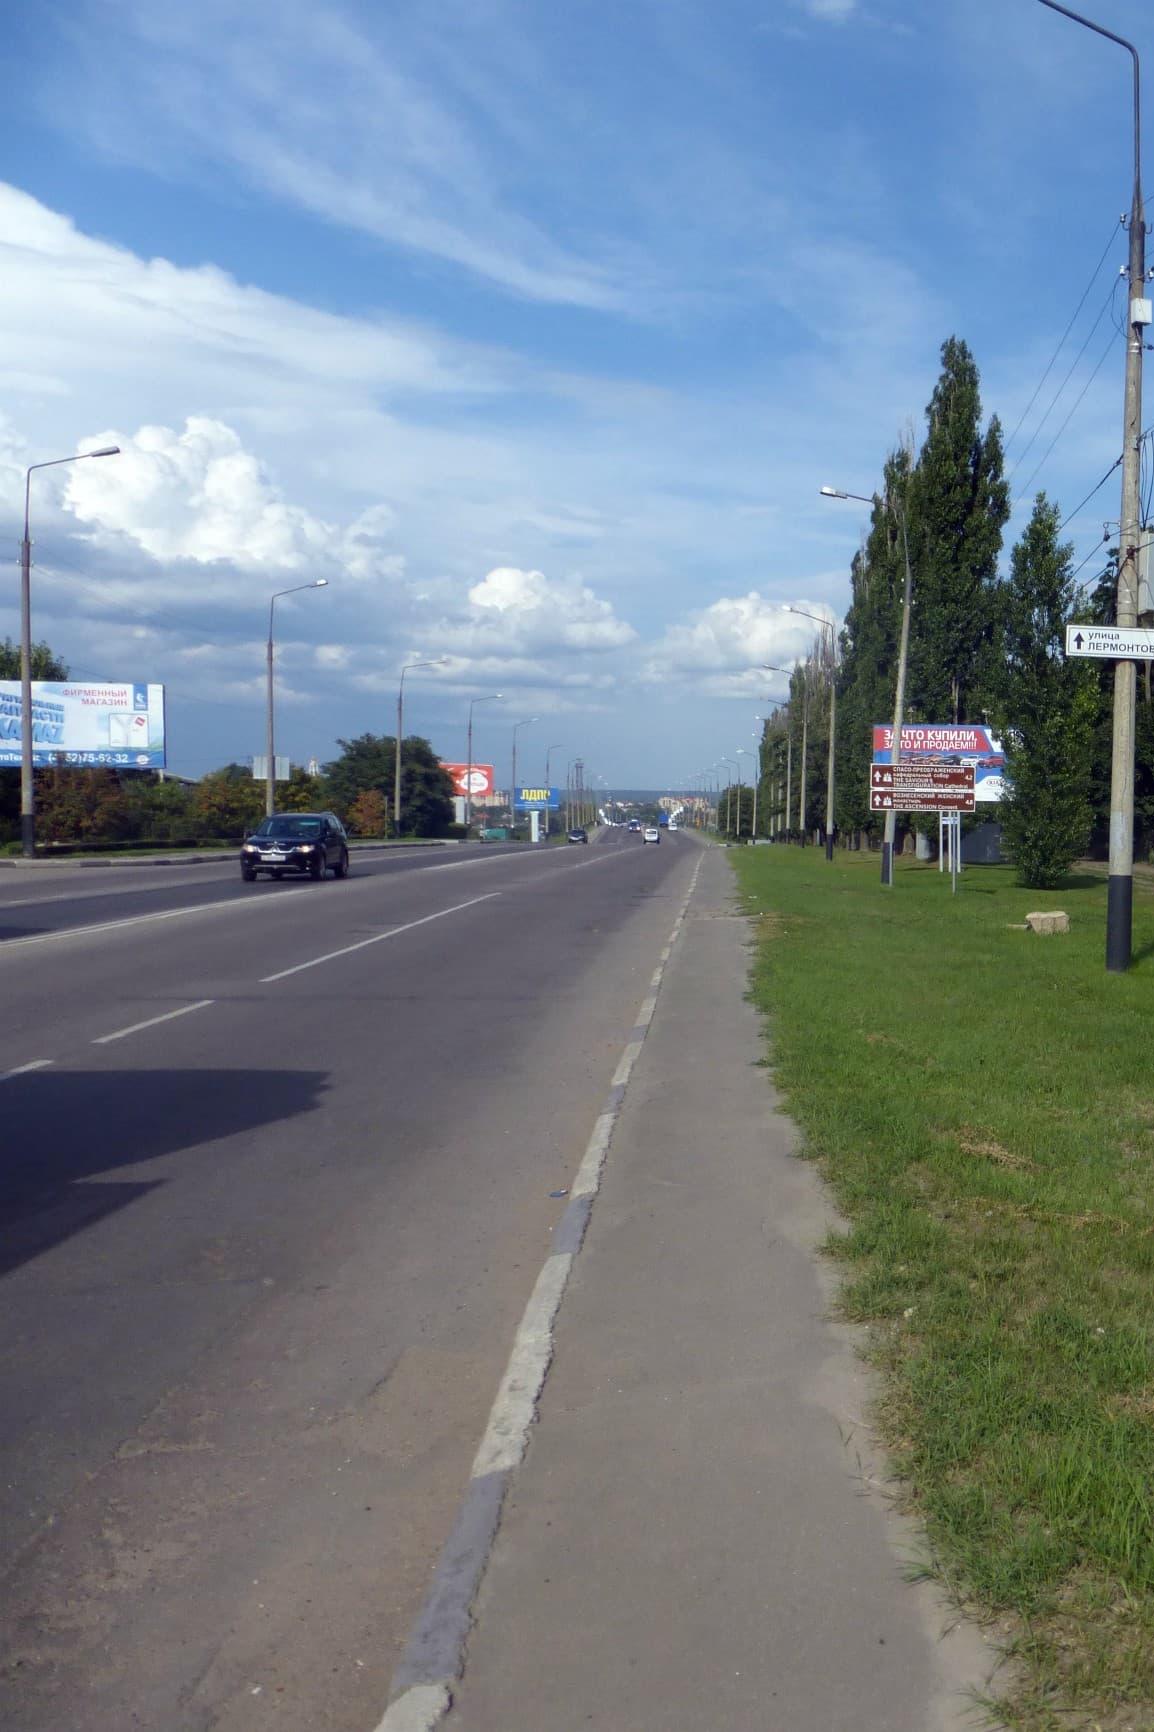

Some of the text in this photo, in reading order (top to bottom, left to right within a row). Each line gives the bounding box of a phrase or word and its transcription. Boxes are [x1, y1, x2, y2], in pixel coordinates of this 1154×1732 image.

[1088, 632, 1120, 641] улица
[63, 688, 128, 697] ФИРМЕННЫЙ
[81, 698, 128, 706] МАГАЗИН
[902, 730, 925, 740] ЧТО
[927, 730, 978, 741] КУПИЛИ,
[913, 740, 921, 749] И
